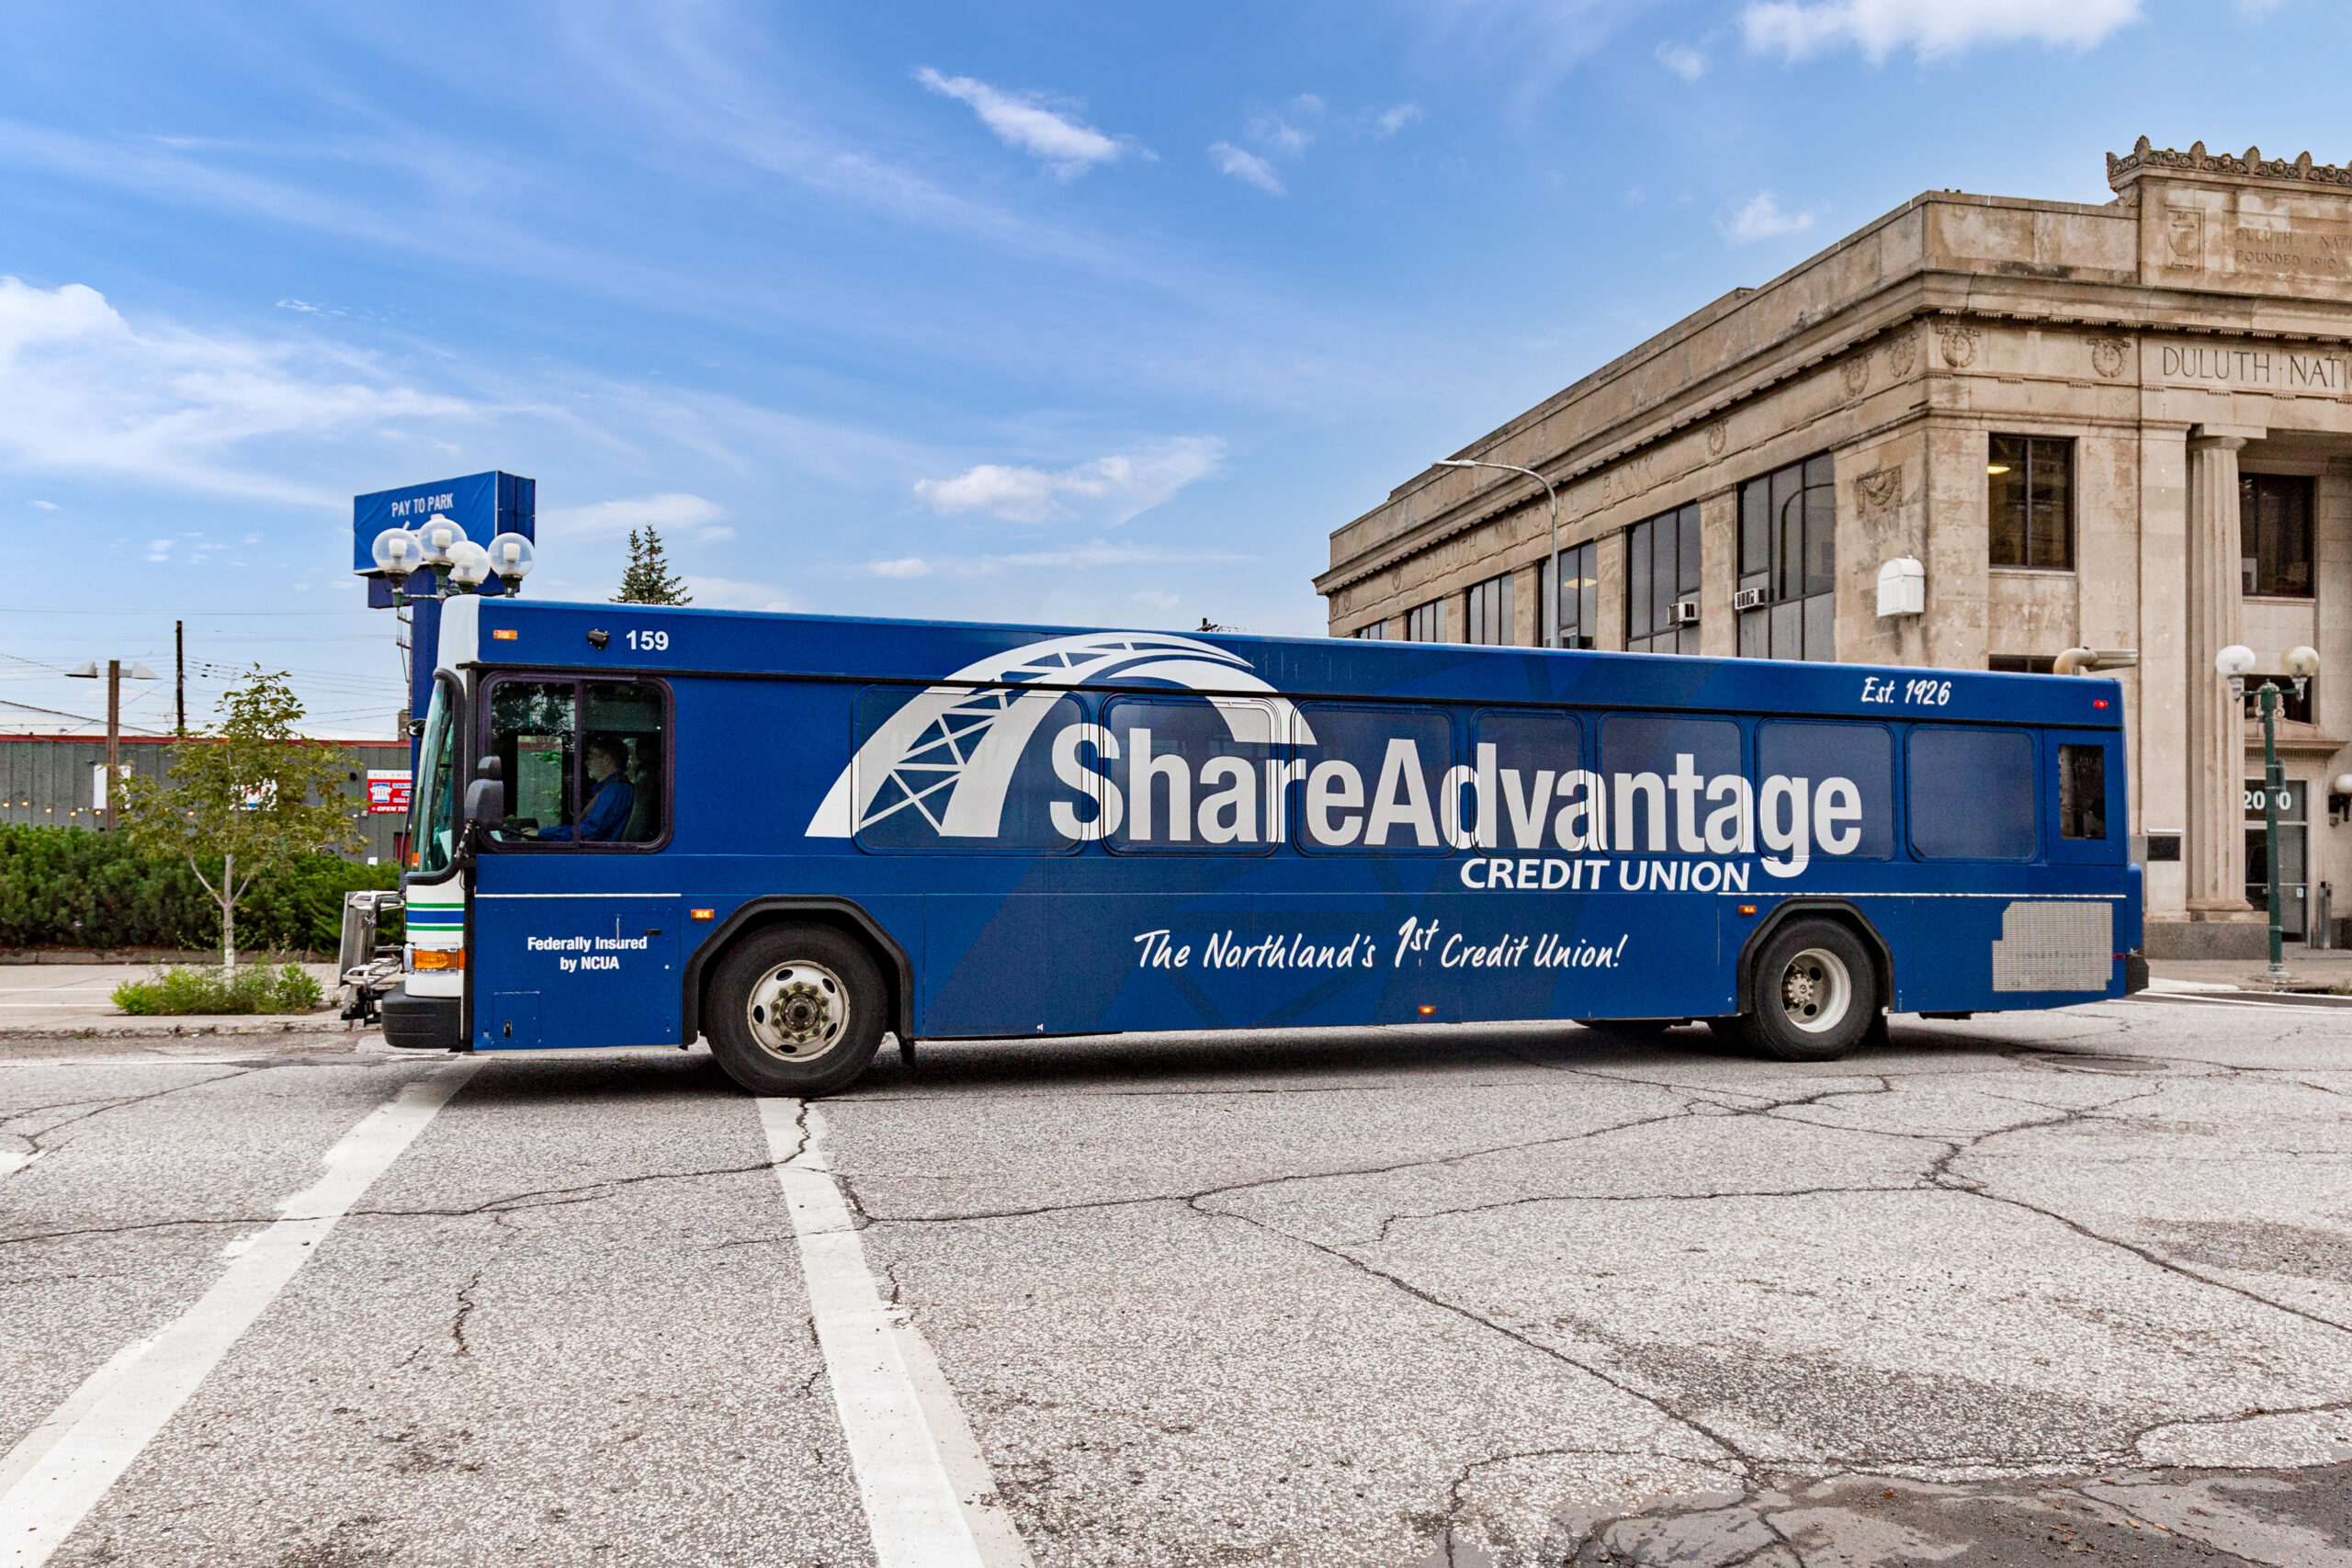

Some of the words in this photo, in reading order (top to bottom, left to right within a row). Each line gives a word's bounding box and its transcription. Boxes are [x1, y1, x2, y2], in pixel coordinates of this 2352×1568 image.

[2234, 250, 2301, 265] FOUNDED
[2163, 346, 2270, 382] DULUTH
[2290, 355, 2352, 389] NATI
[1602, 456, 1655, 500] BANK
[391, 500, 411, 517] PAY
[413, 498, 425, 513] TO
[427, 493, 453, 512] PARK
[626, 630, 669, 651] 159
[1860, 676, 1895, 704] Est.
[1905, 679, 1951, 705] 1926
[1049, 722, 1862, 878] ShareAdvantage
[2244, 791, 2292, 810] 200
[1460, 857, 1611, 890] CREDIT
[1619, 860, 1751, 892] UNION
[527, 936, 592, 953] Federally
[595, 936, 648, 950] Insured
[1135, 930, 1191, 968] The
[1204, 930, 1376, 969] Northland's
[1395, 916, 1440, 968] 1st
[1442, 933, 1529, 968] Credit
[1534, 933, 1629, 968] Union!
[560, 956, 577, 973] by
[581, 955, 620, 970] NCUA
